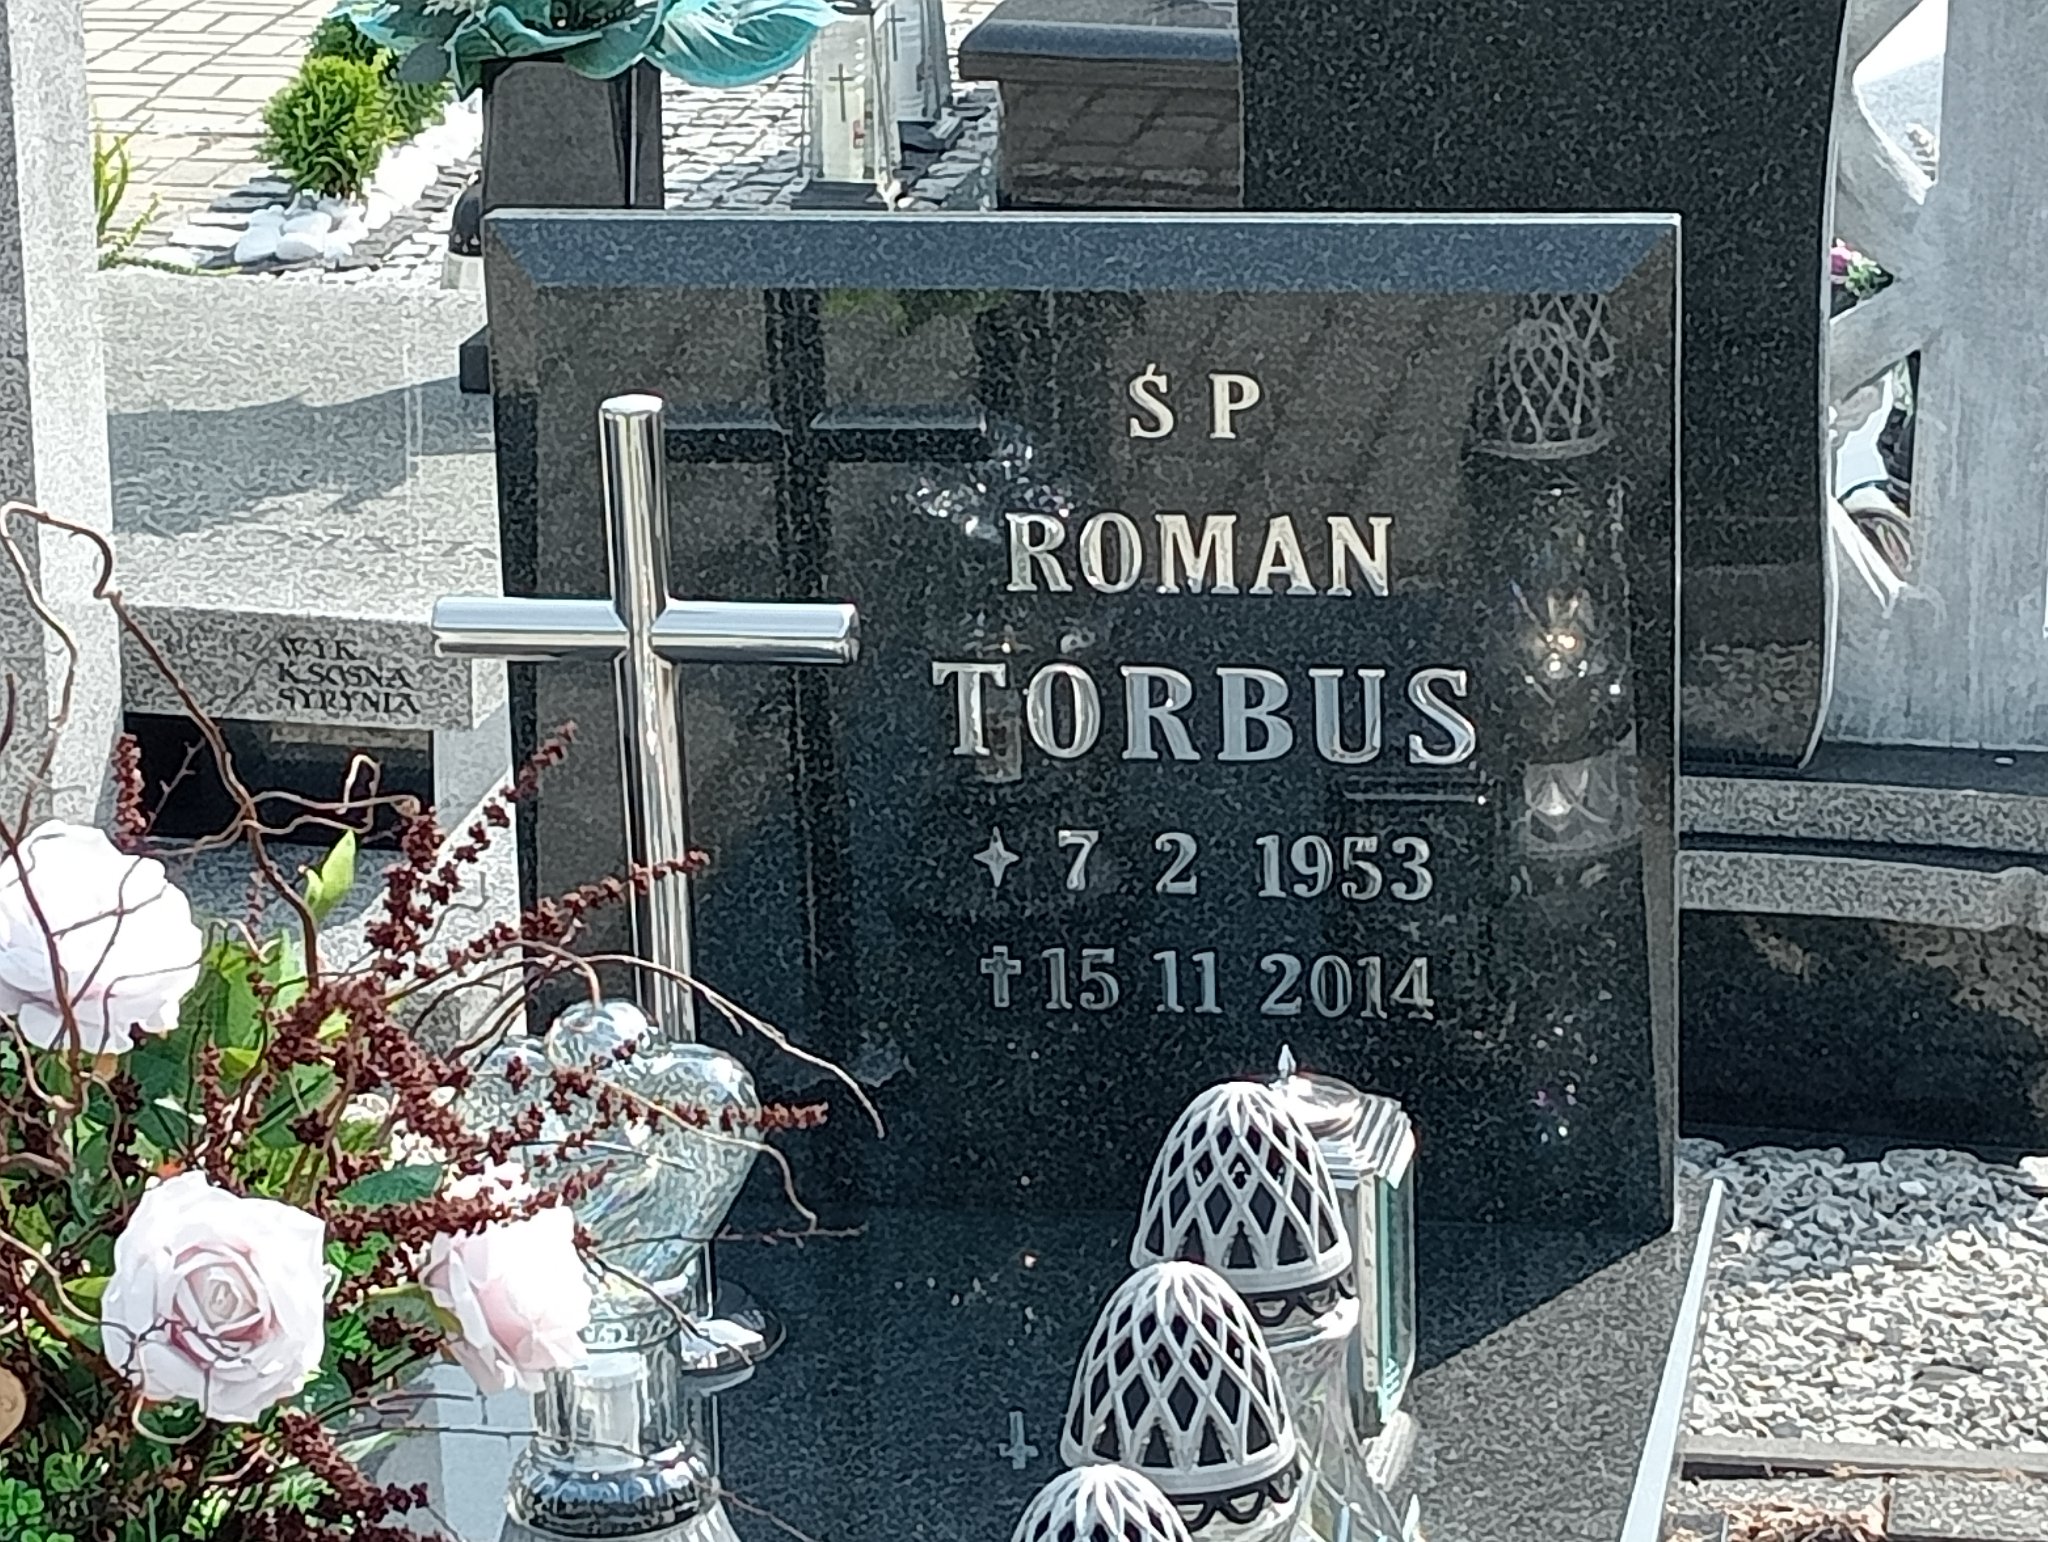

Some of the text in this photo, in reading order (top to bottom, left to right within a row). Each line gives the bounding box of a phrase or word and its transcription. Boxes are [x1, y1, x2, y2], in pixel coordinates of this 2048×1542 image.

[1129, 363, 1260, 440] Ś P
[1005, 512, 1393, 597] ROMAN
[932, 661, 1476, 765] TORBUS
[1058, 829, 1433, 900] 7 2 1953
[1042, 947, 1434, 1020] 15 11 2014
